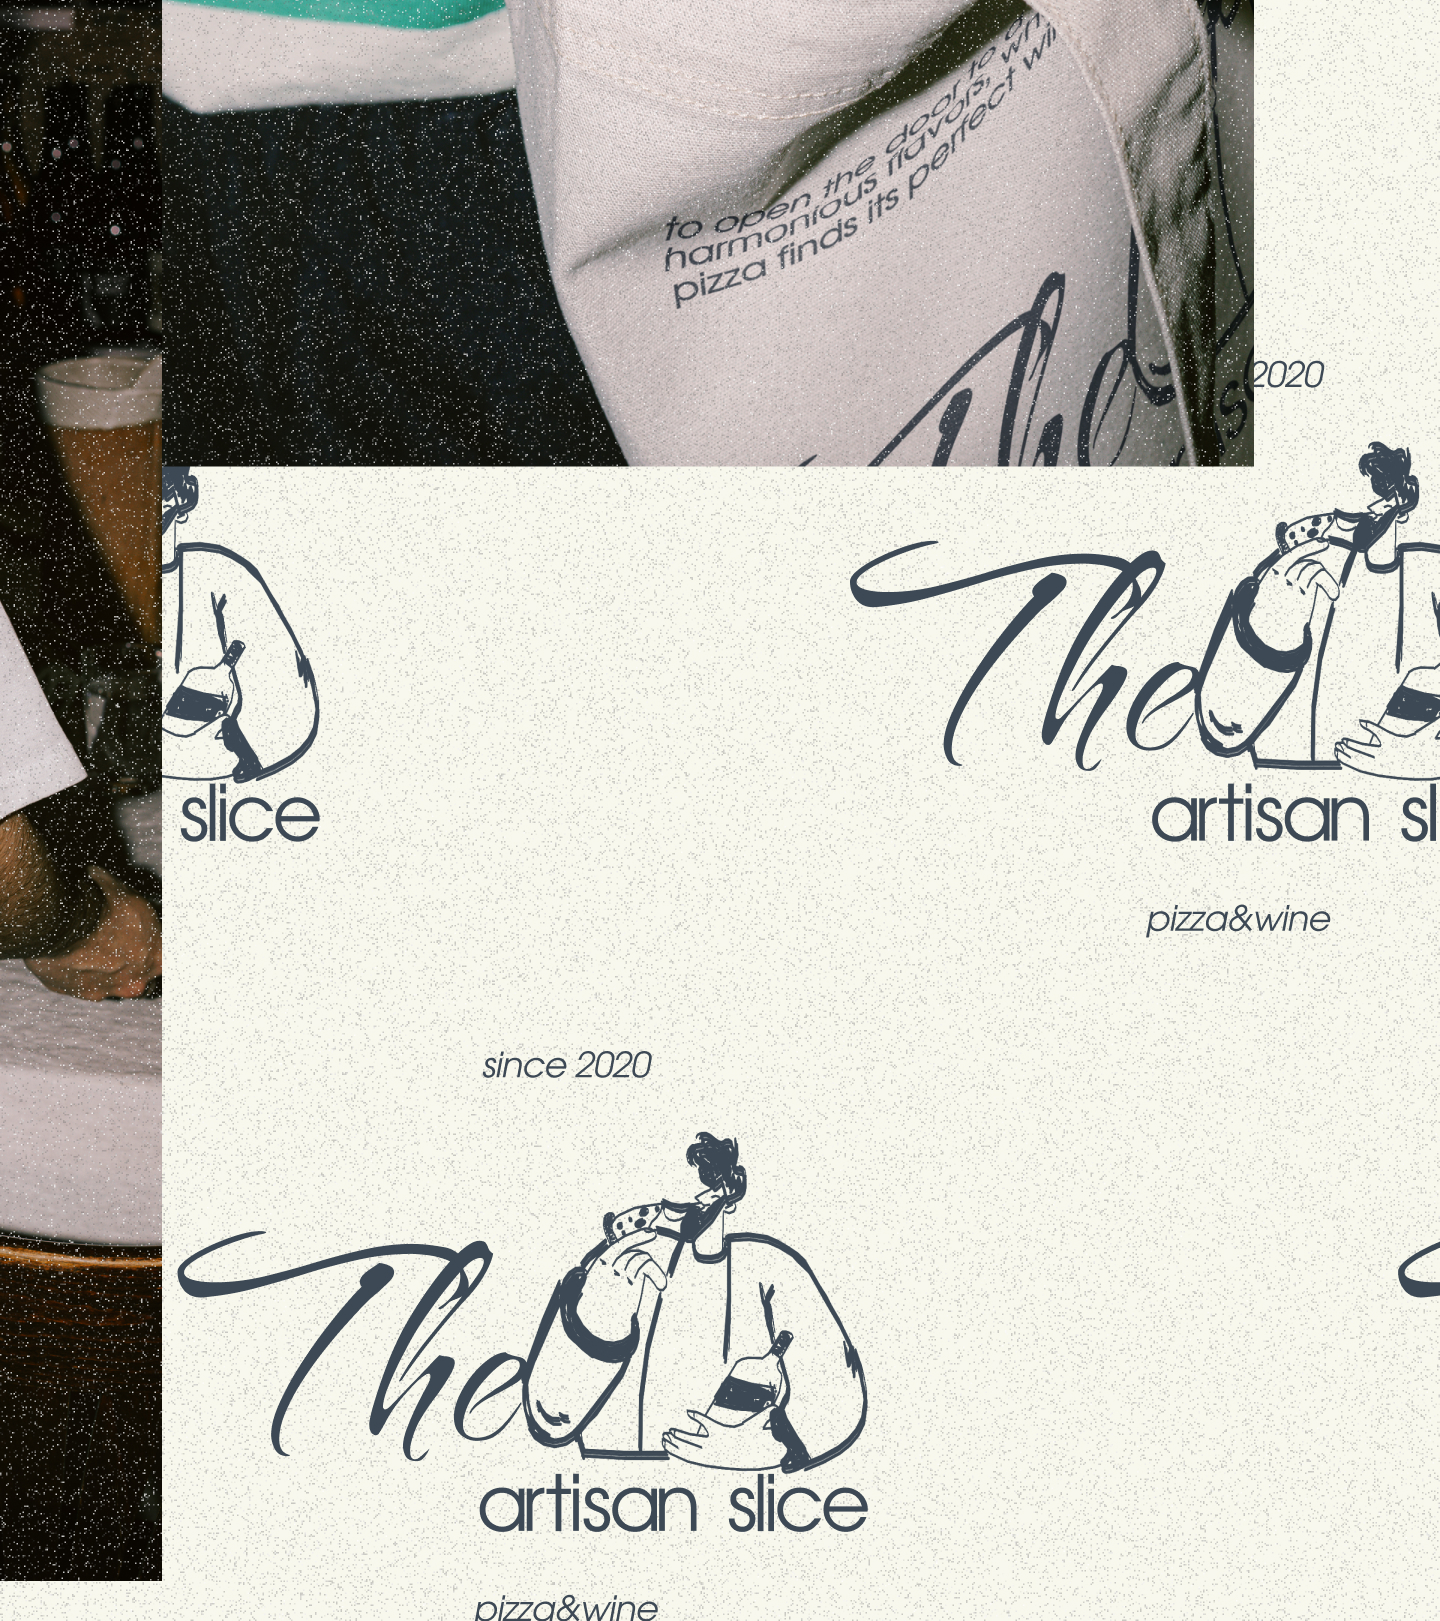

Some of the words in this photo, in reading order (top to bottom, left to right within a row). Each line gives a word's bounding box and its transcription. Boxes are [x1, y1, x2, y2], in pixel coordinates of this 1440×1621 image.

[665, 216, 703, 241] to
[714, 193, 811, 233] open
[823, 155, 876, 198] the
[886, 79, 962, 154] door
[968, 46, 997, 80] to
[674, 259, 766, 309] pizza
[777, 216, 859, 269] finds
[868, 188, 899, 224] its
[909, 66, 1016, 200] perfect
[665, 172, 878, 271] harmonious
[850, 541, 1196, 771] The
[181, 784, 320, 842] slice
[1152, 784, 1369, 842] artisan
[1146, 904, 1331, 938] pizza&wine
[483, 1050, 567, 1078] since
[575, 1050, 653, 1078] 2020
[178, 1231, 524, 1461] The
[480, 1474, 697, 1532] artisan
[729, 1474, 868, 1532] slice
[474, 1594, 659, 1621] pizza&wine
